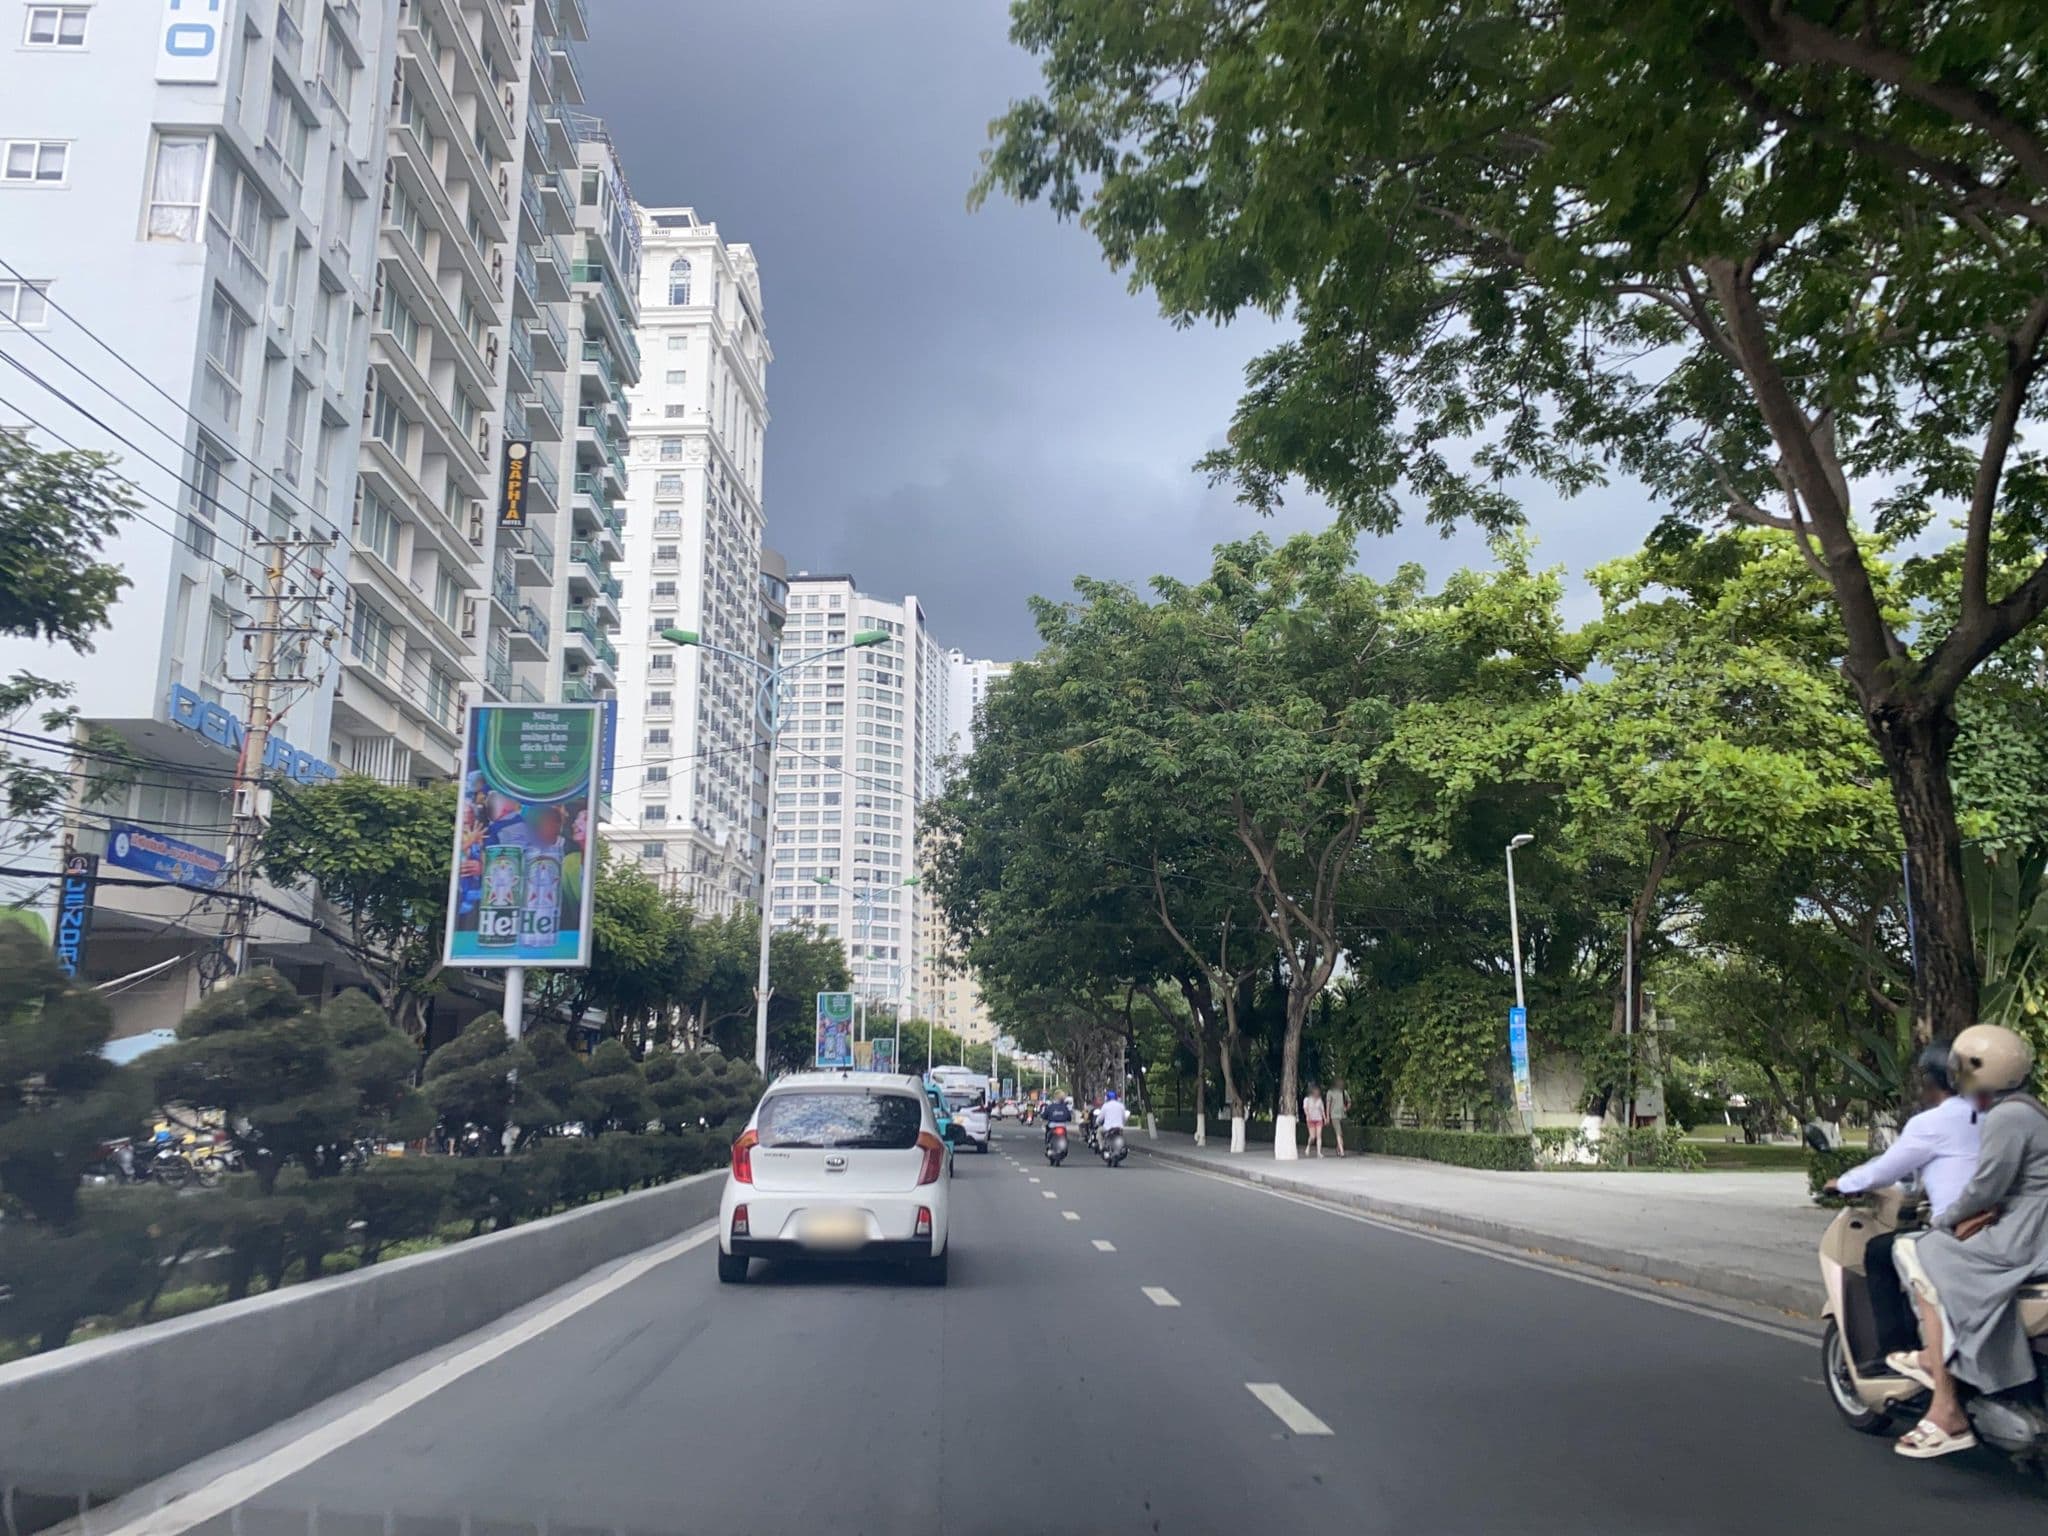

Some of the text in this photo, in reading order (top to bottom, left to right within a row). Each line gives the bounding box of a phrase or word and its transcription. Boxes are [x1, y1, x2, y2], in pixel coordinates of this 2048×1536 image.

[505, 460, 523, 520] SAPHIA
[478, 910, 519, 936] Hei
[520, 909, 559, 934] Hei
